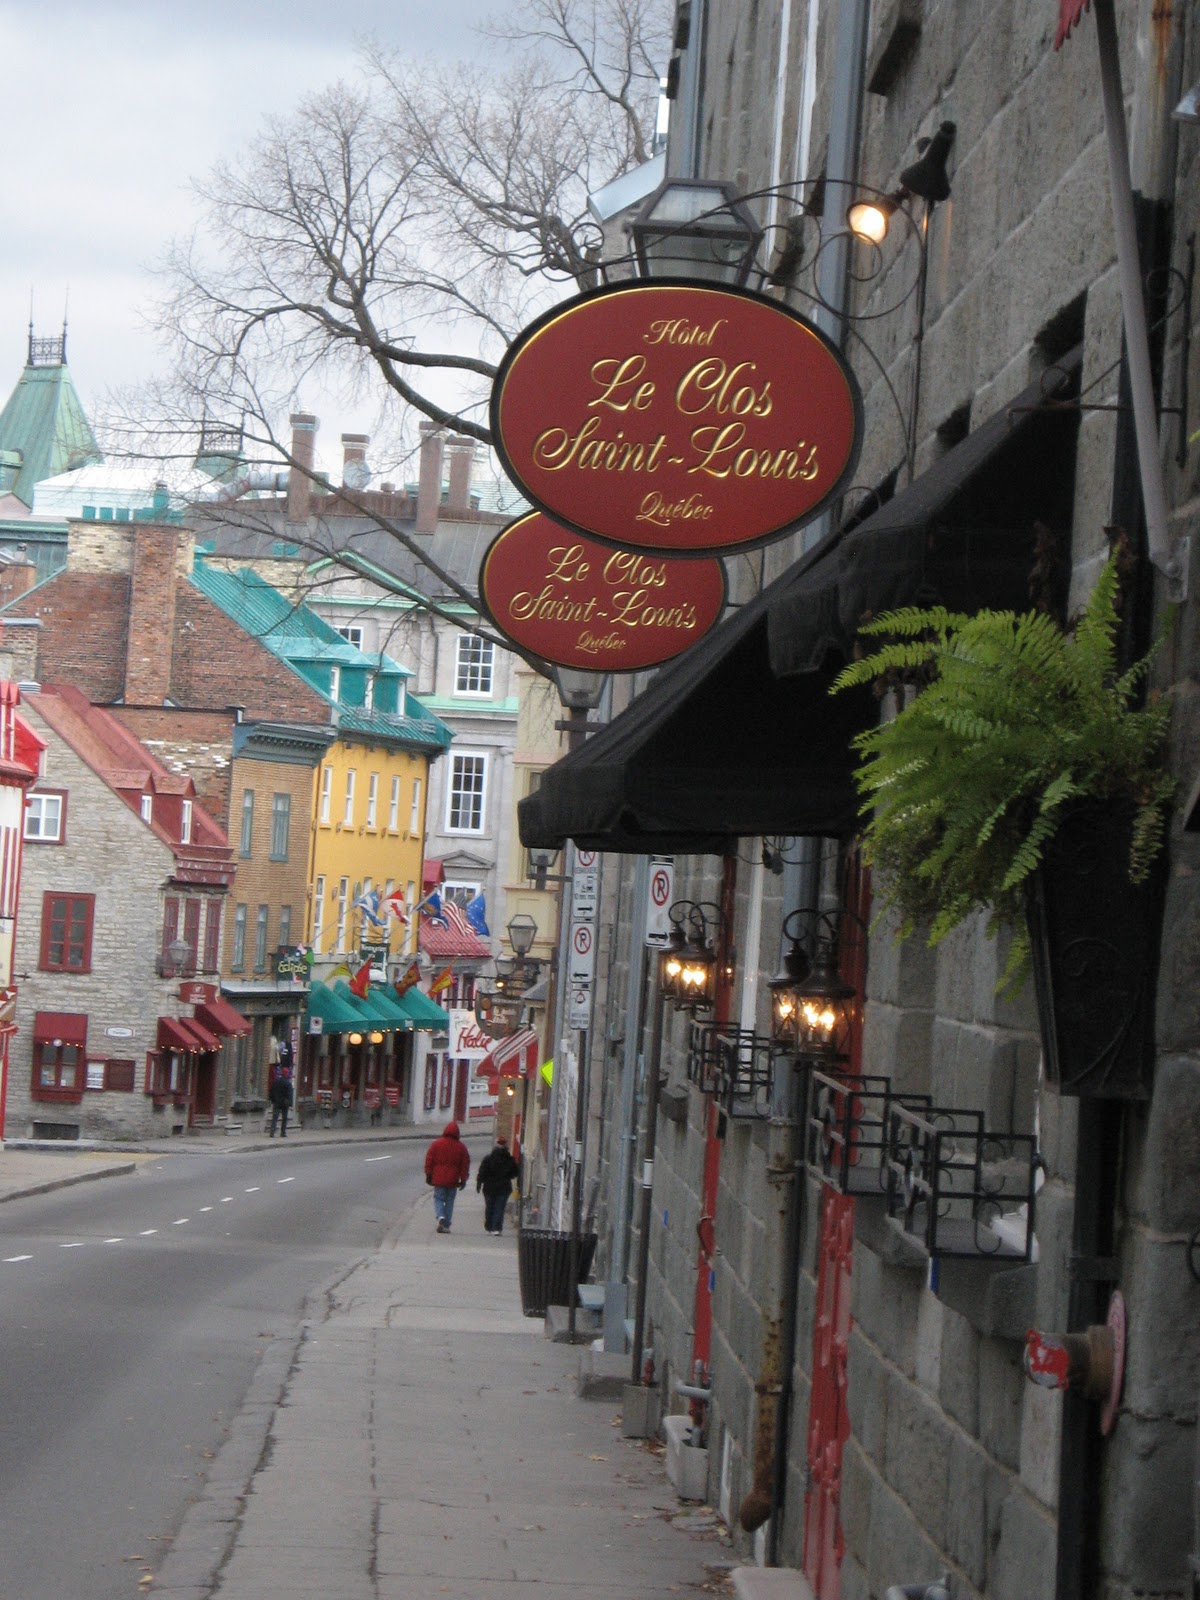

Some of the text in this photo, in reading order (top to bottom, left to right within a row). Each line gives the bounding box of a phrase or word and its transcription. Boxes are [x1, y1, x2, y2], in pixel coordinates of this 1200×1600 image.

[643, 318, 728, 347] Hôtel
[588, 354, 774, 417] Le Clos
[635, 490, 714, 526] Québec
[545, 544, 667, 587] Le Clos
[575, 630, 627, 654] Québec
